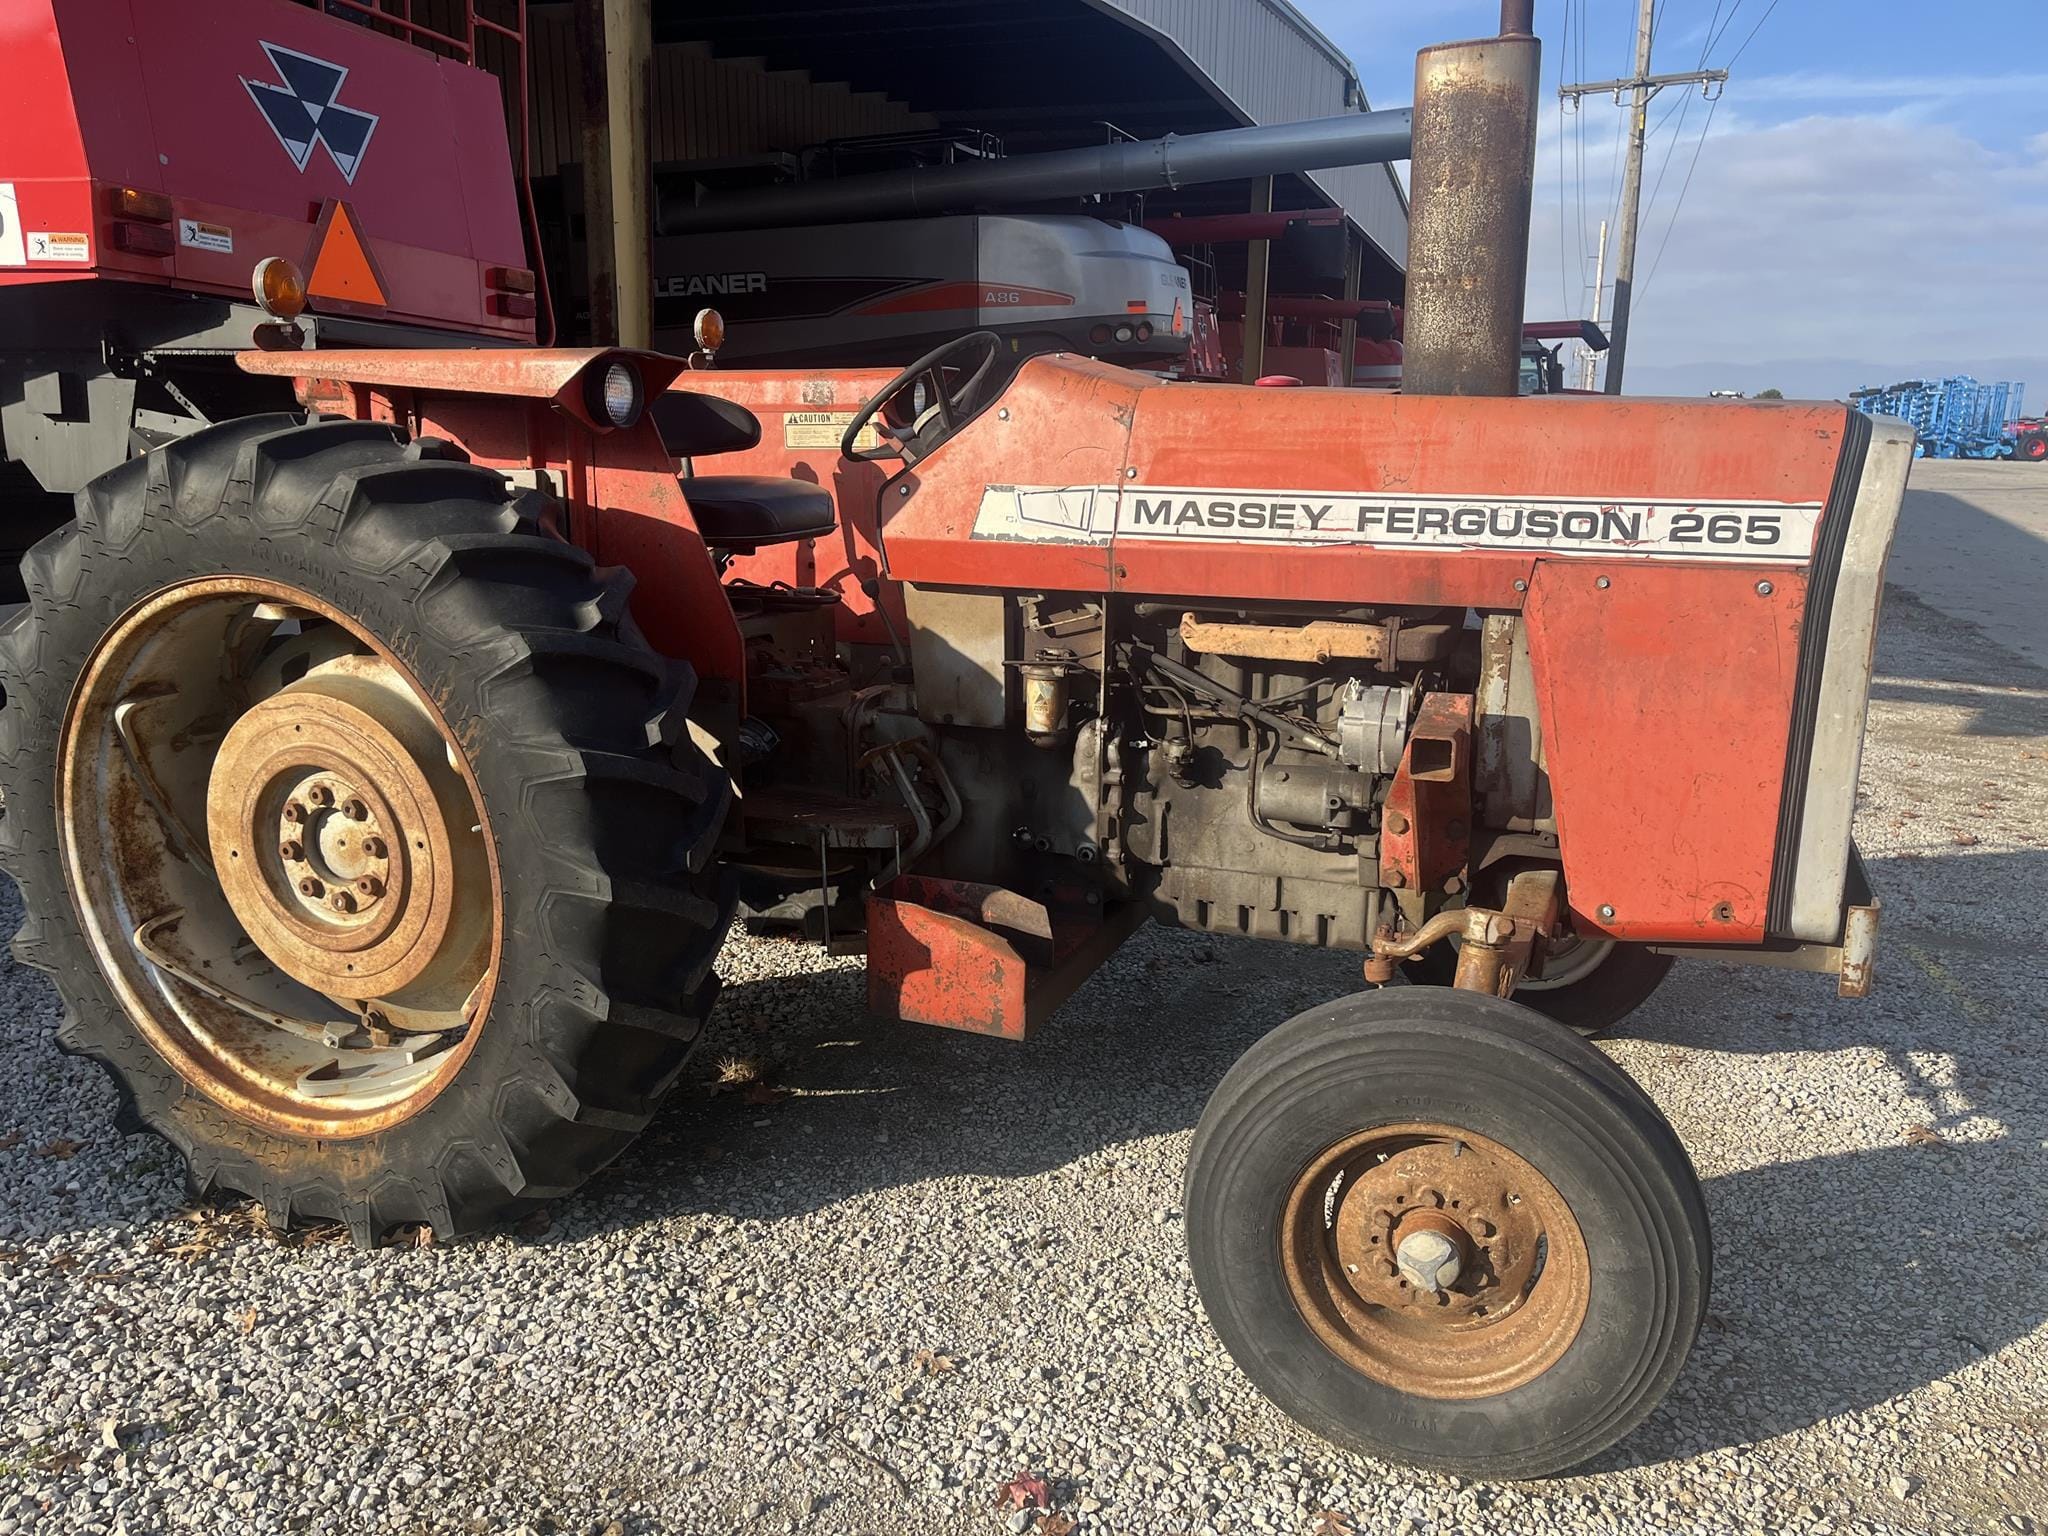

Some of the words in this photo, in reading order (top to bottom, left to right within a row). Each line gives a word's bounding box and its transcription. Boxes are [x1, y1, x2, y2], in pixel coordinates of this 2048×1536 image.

[654, 273, 767, 297] LEANER
[985, 292, 1020, 303] A86
[799, 414, 831, 423] CAUTION
[1133, 499, 1333, 531] MASSEY
[1357, 506, 1642, 541] FERGUSON
[1668, 513, 1782, 545] 265
